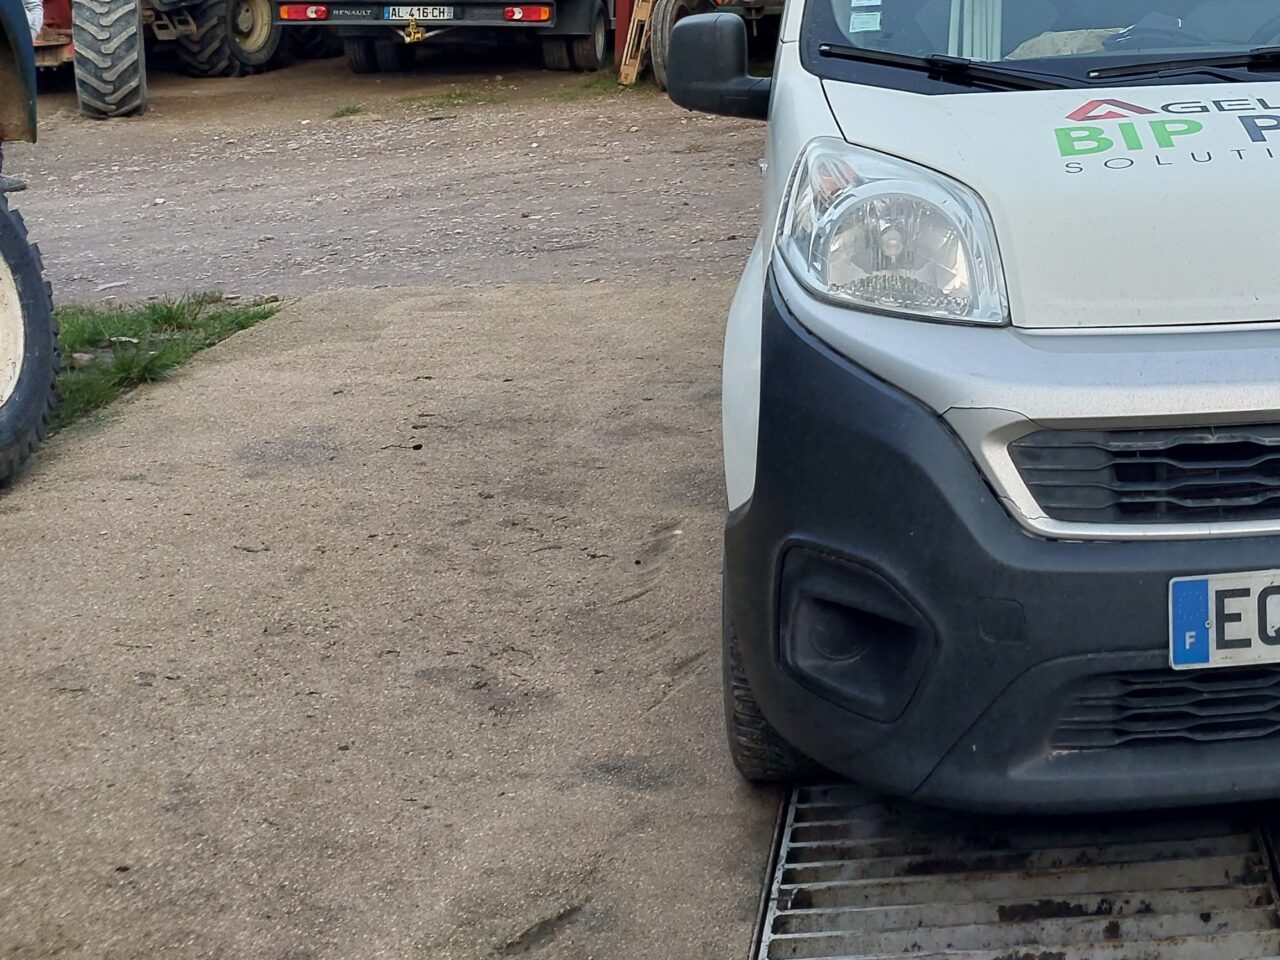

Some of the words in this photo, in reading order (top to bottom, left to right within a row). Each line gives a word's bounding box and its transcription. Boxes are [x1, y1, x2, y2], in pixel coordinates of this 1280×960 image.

[332, 8, 373, 17] RENAULT
[390, 7, 446, 19] AL-416-CH
[1053, 118, 1204, 158] BIP
[1185, 631, 1196, 650] F
